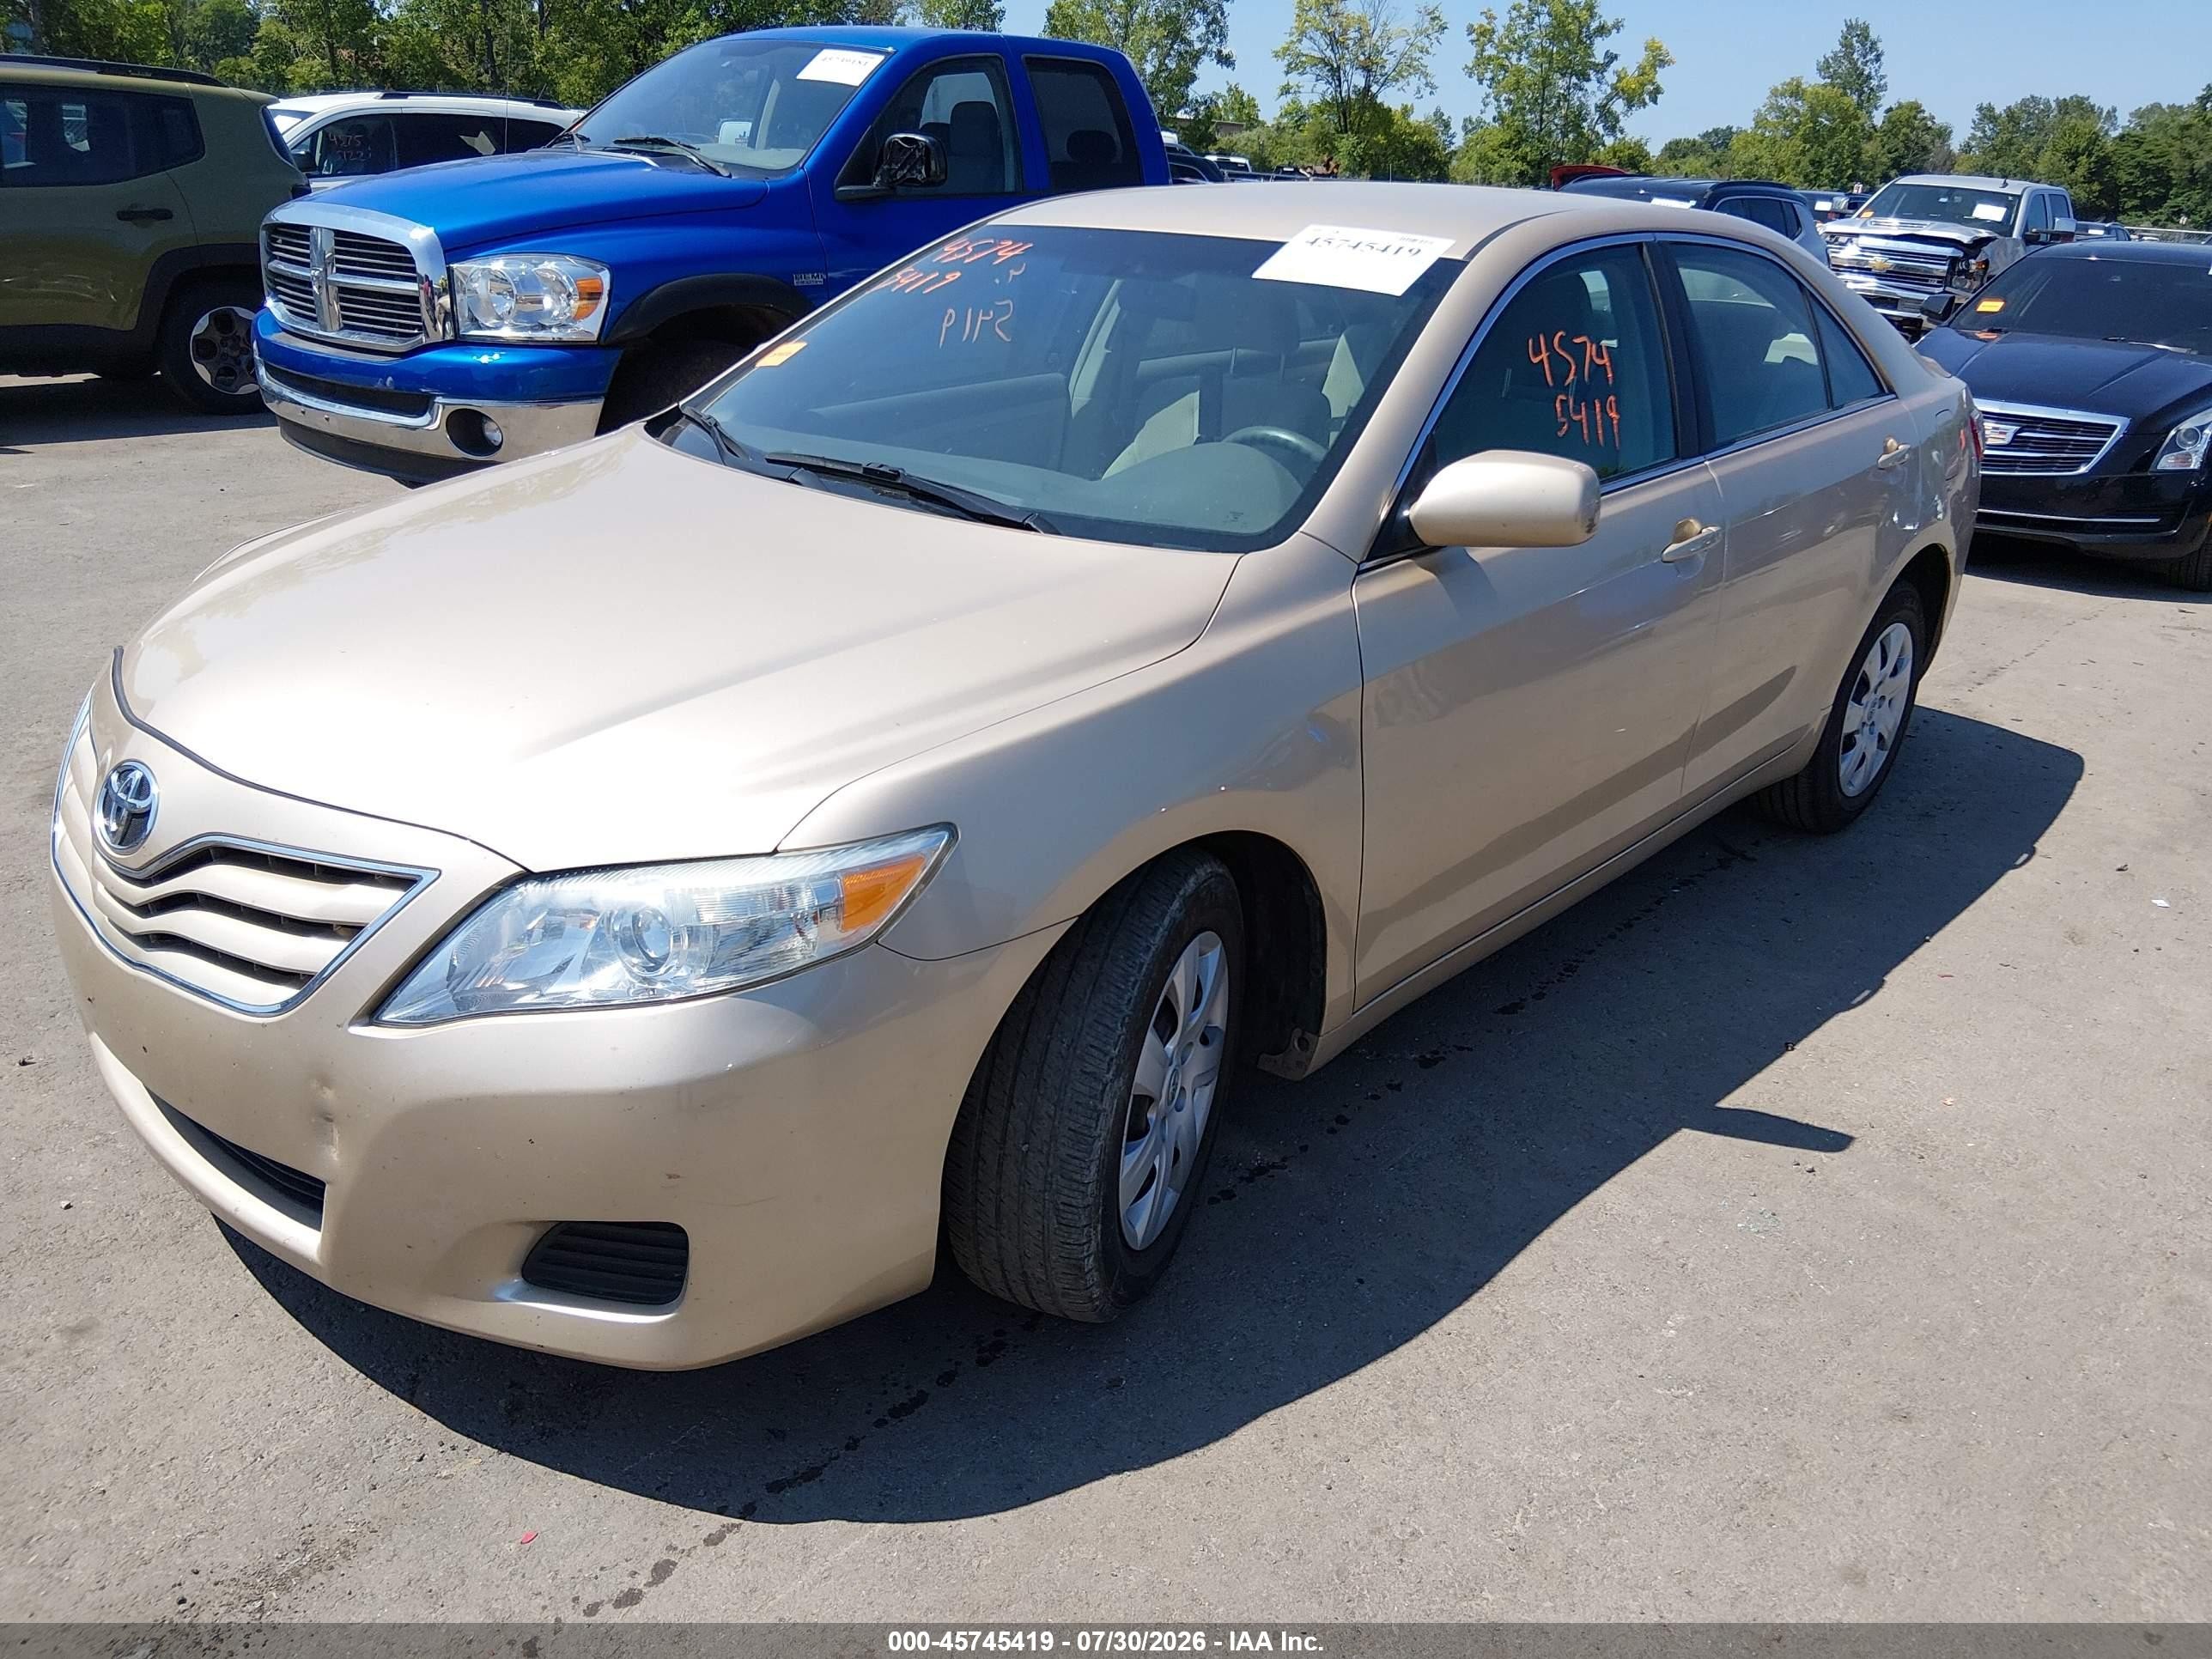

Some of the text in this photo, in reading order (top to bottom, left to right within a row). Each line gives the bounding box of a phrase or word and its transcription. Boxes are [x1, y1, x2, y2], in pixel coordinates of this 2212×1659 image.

[932, 237, 1034, 265] 4574
[1527, 330, 1614, 387] 4574
[1554, 393, 1620, 450] 5419
